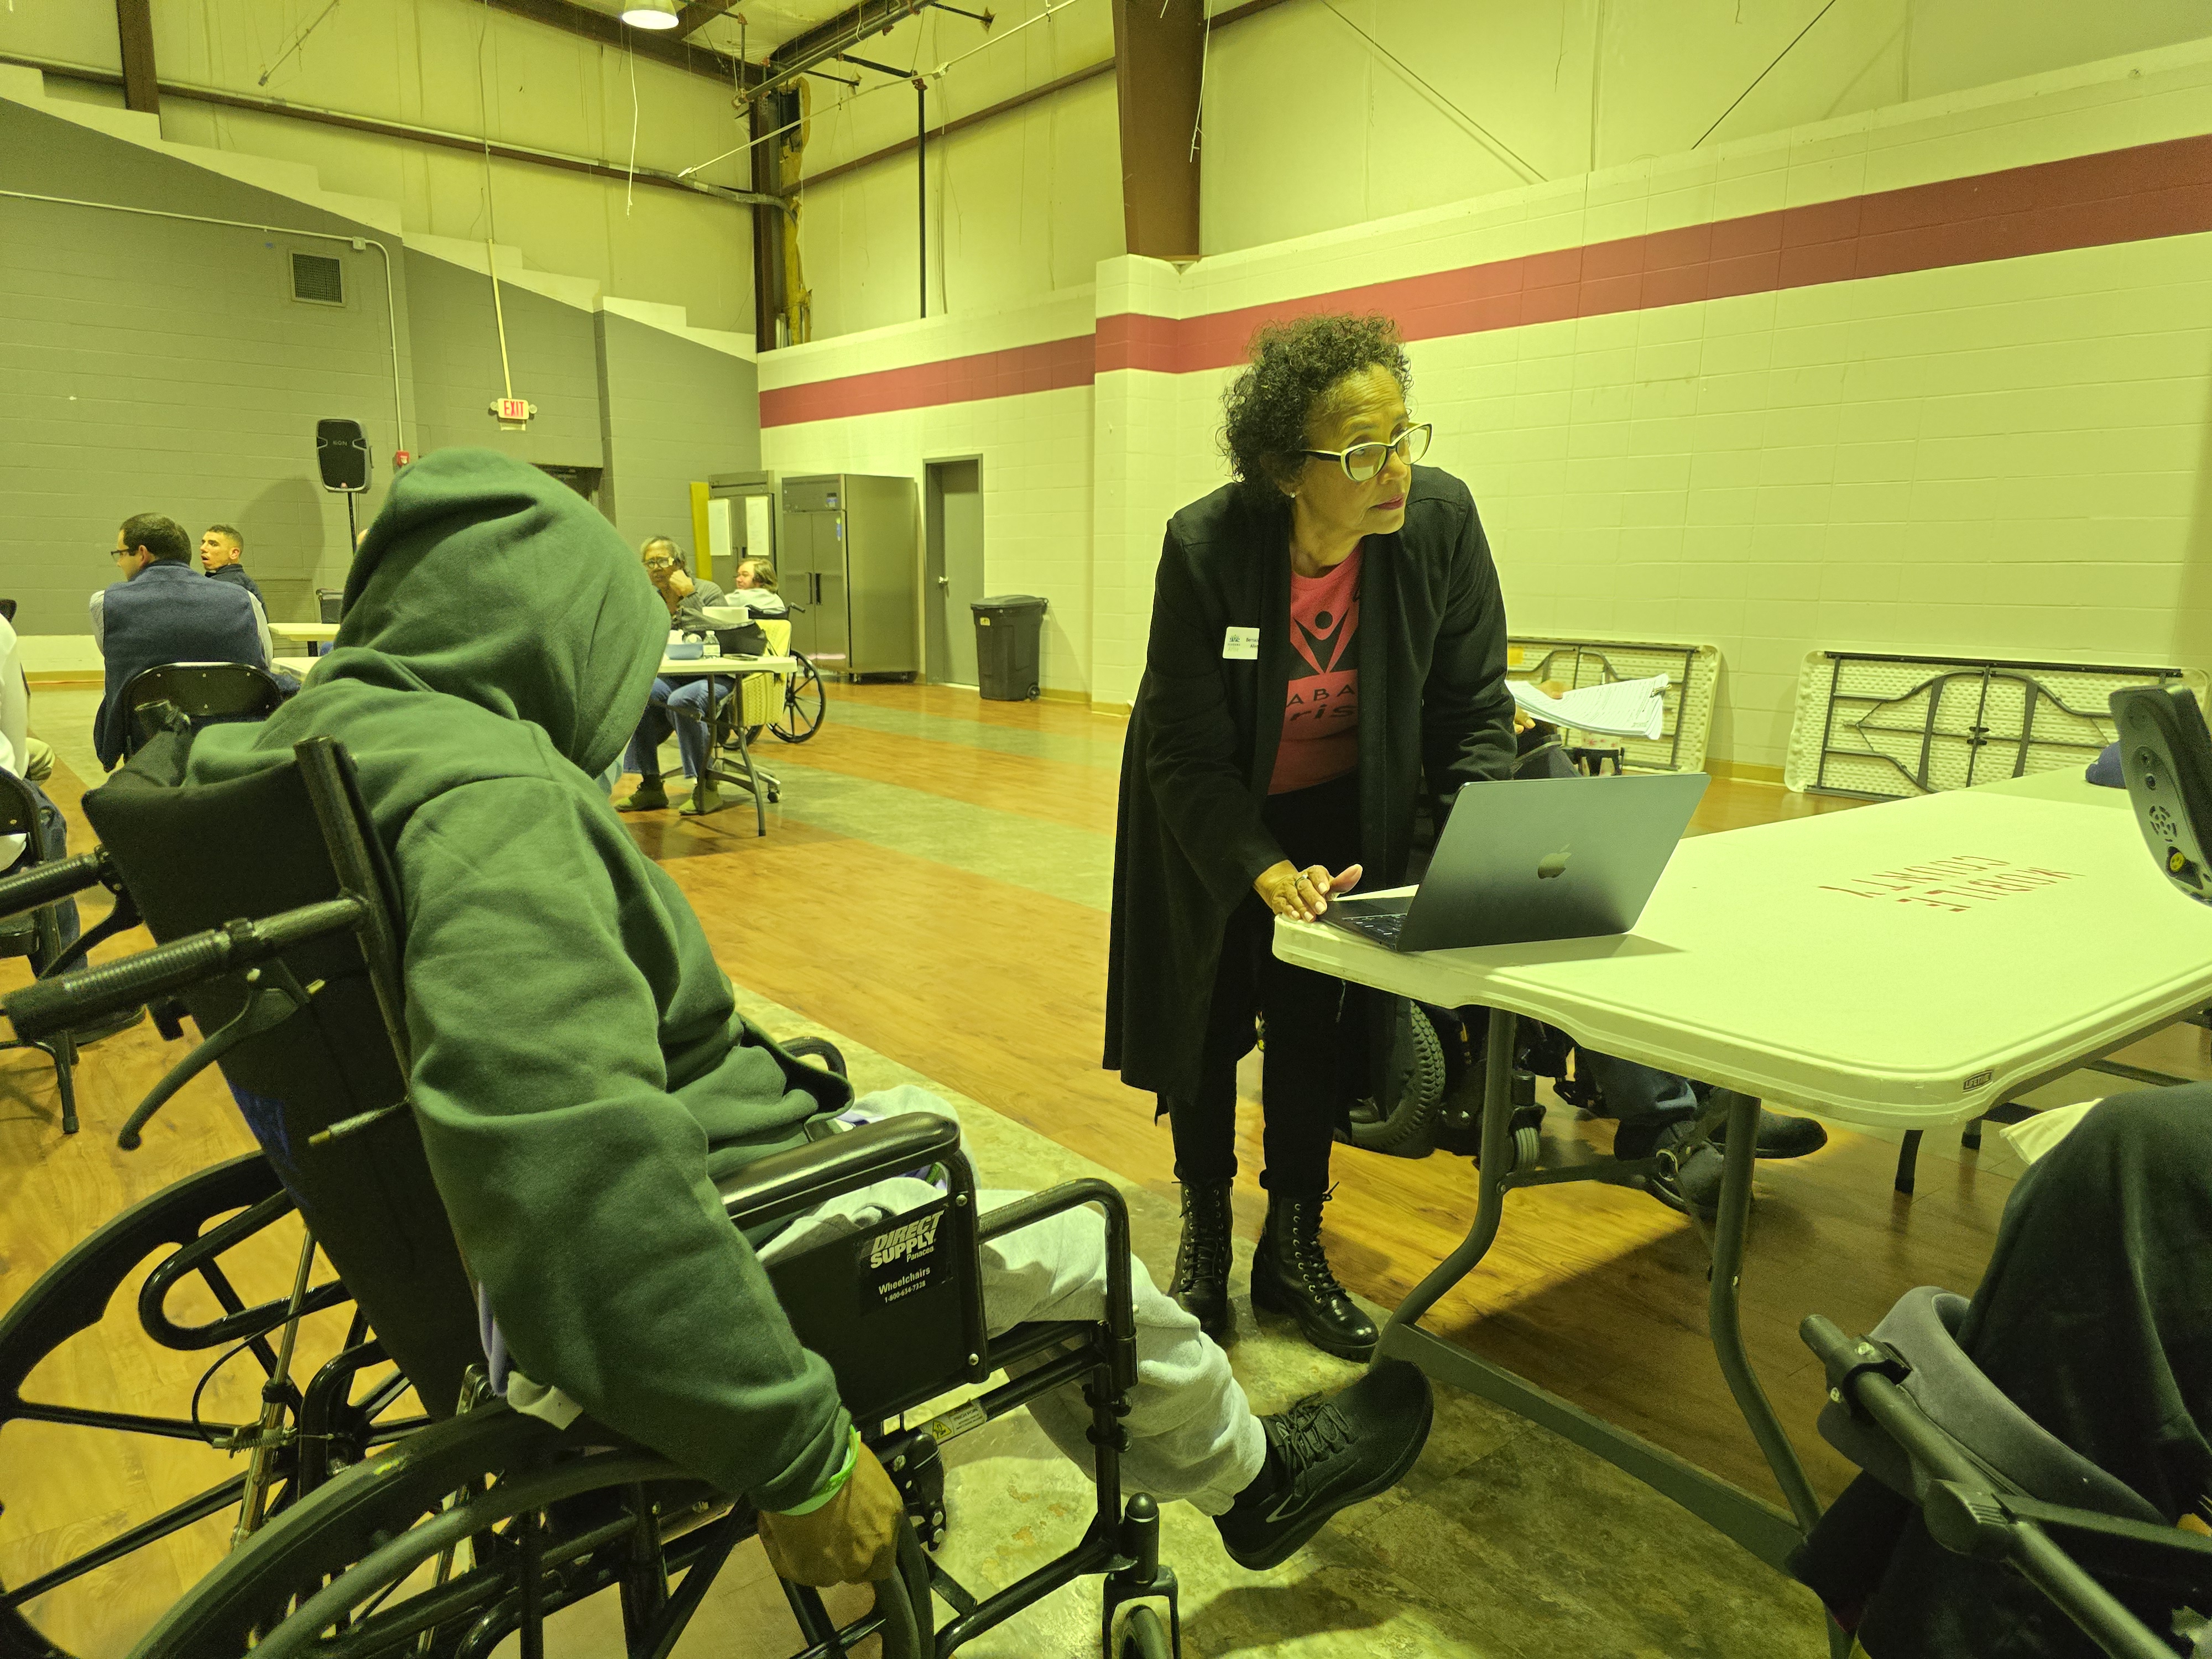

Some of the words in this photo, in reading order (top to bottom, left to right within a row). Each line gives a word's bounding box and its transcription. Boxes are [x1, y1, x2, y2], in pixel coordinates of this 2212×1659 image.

[504, 400, 524, 417] EXIT
[1818, 856, 2010, 898] COUNTY
[1896, 867, 2085, 912] MOBILE
[870, 1210, 945, 1255] DIRECT
[870, 1229, 936, 1269] SUPPLY
[878, 1267, 931, 1295] Wheelchairs
